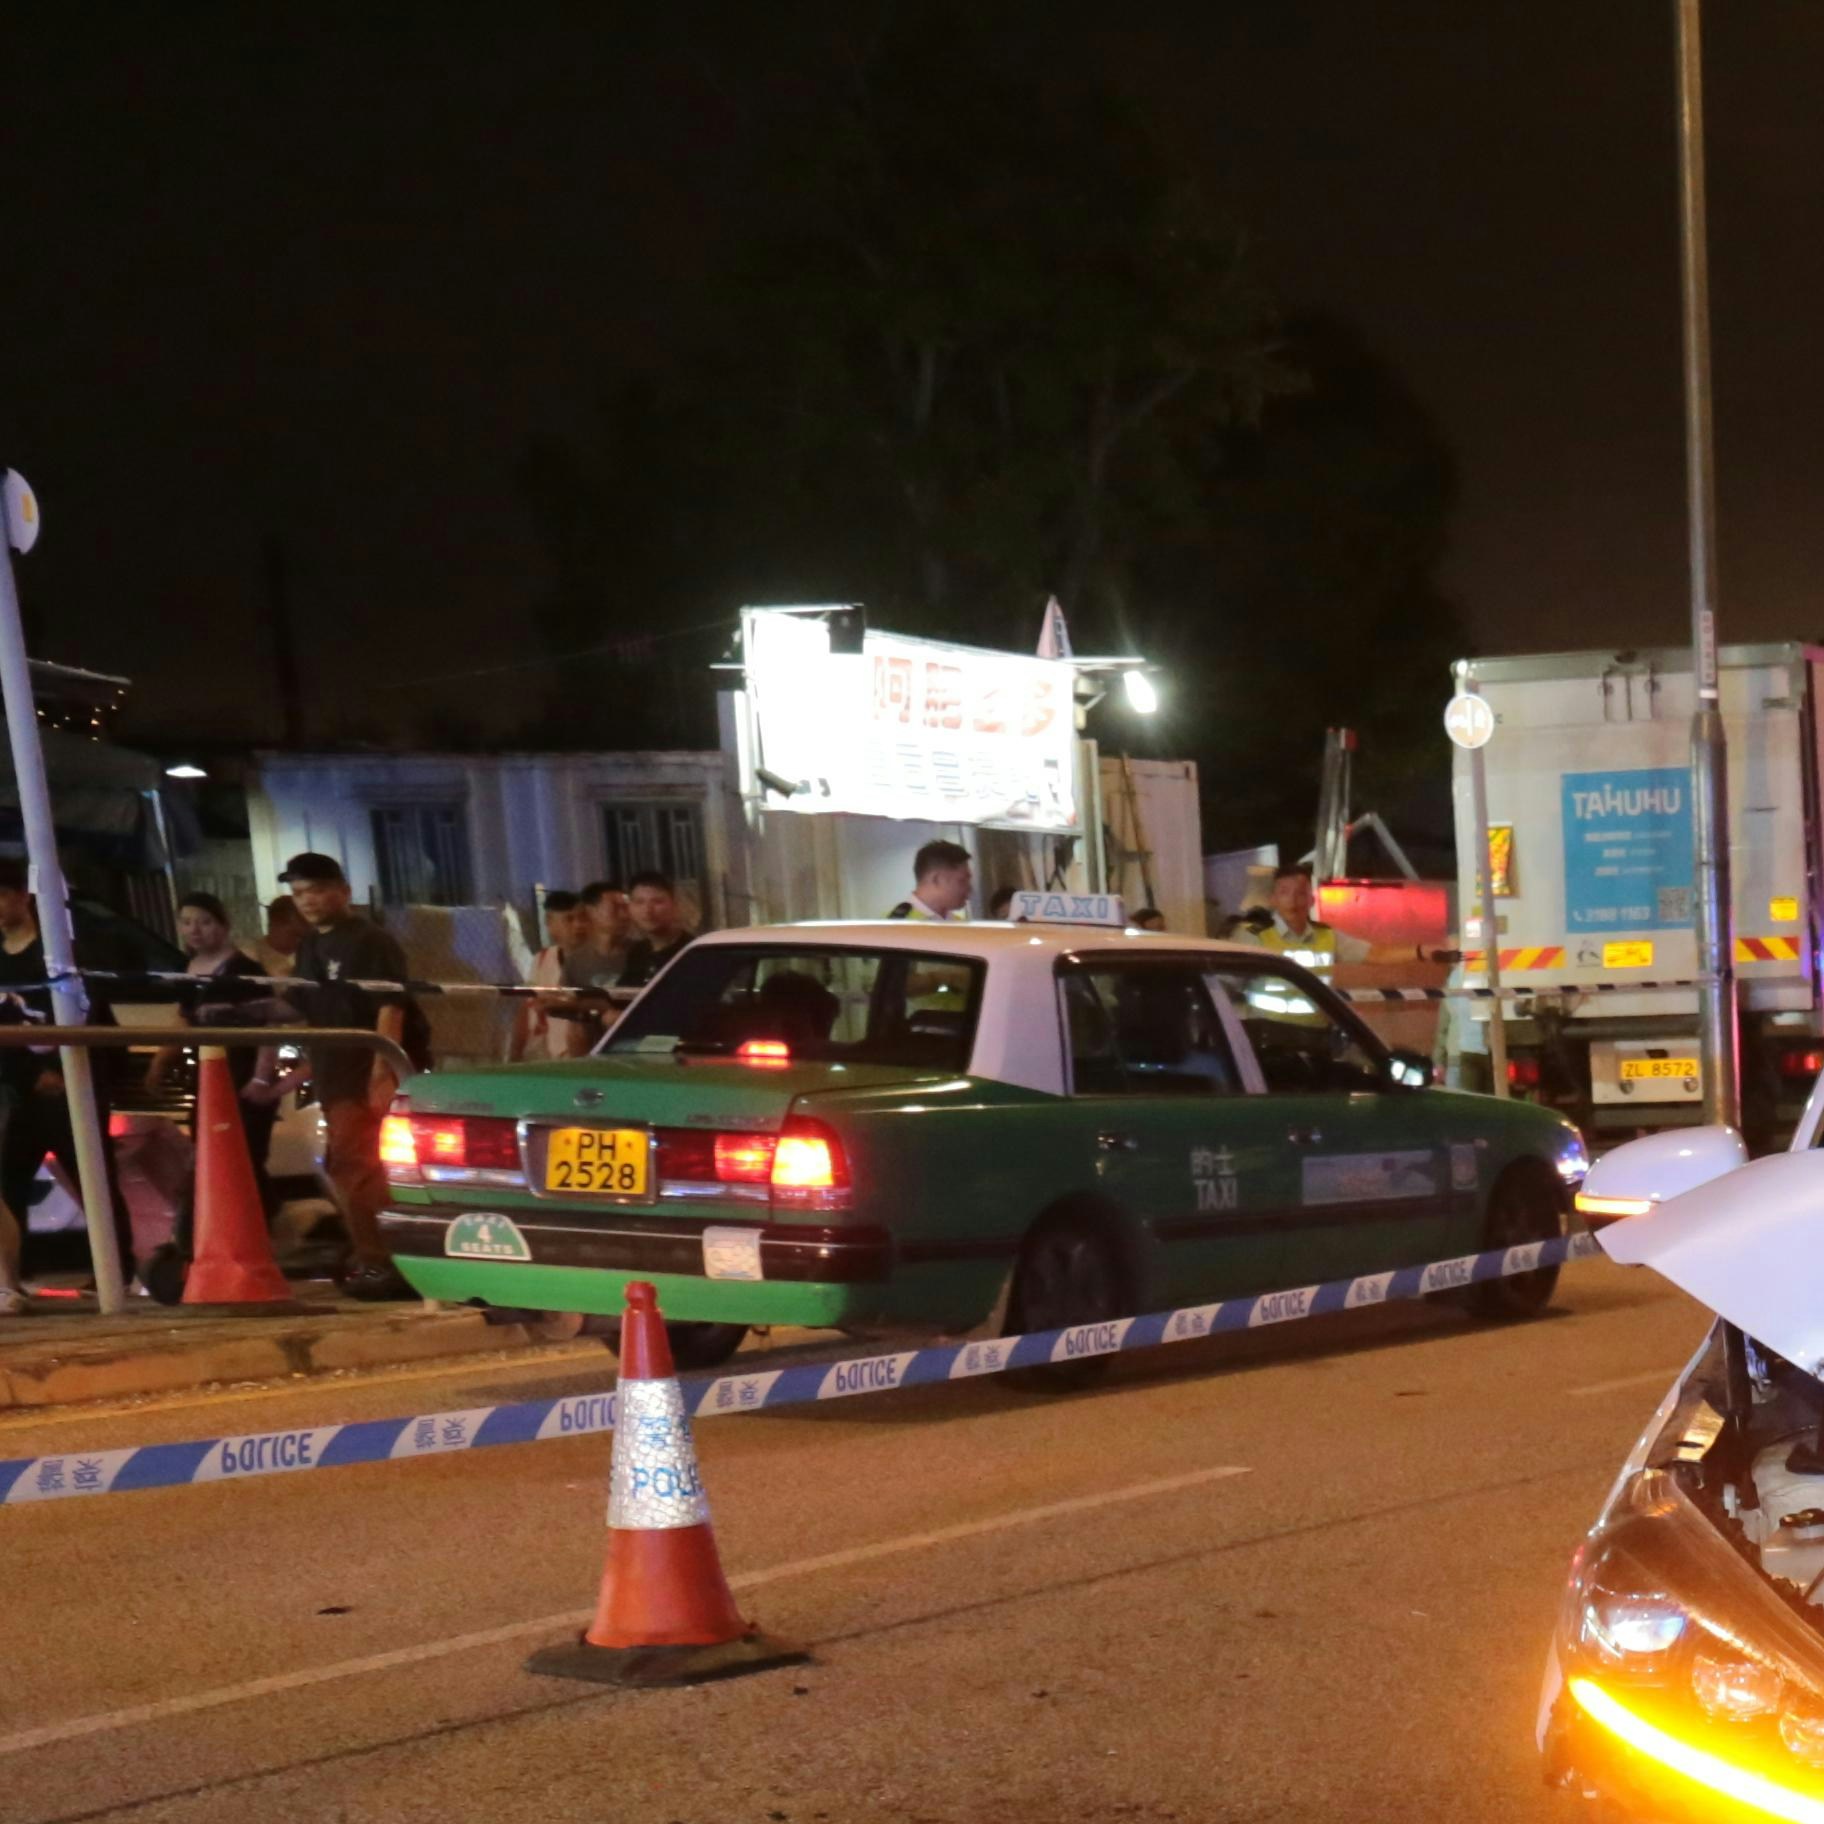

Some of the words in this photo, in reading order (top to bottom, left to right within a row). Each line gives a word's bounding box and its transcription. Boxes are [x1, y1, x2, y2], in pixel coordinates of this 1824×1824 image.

[1019, 895, 1109, 918] TAXI
[1651, 1062, 1695, 1077] 8572
[576, 1132, 618, 1160] PH
[554, 1161, 637, 1190] 2528
[1193, 1176, 1238, 1211] TAXI
[477, 1224, 492, 1243] 4
[460, 1242, 514, 1255] SEATS
